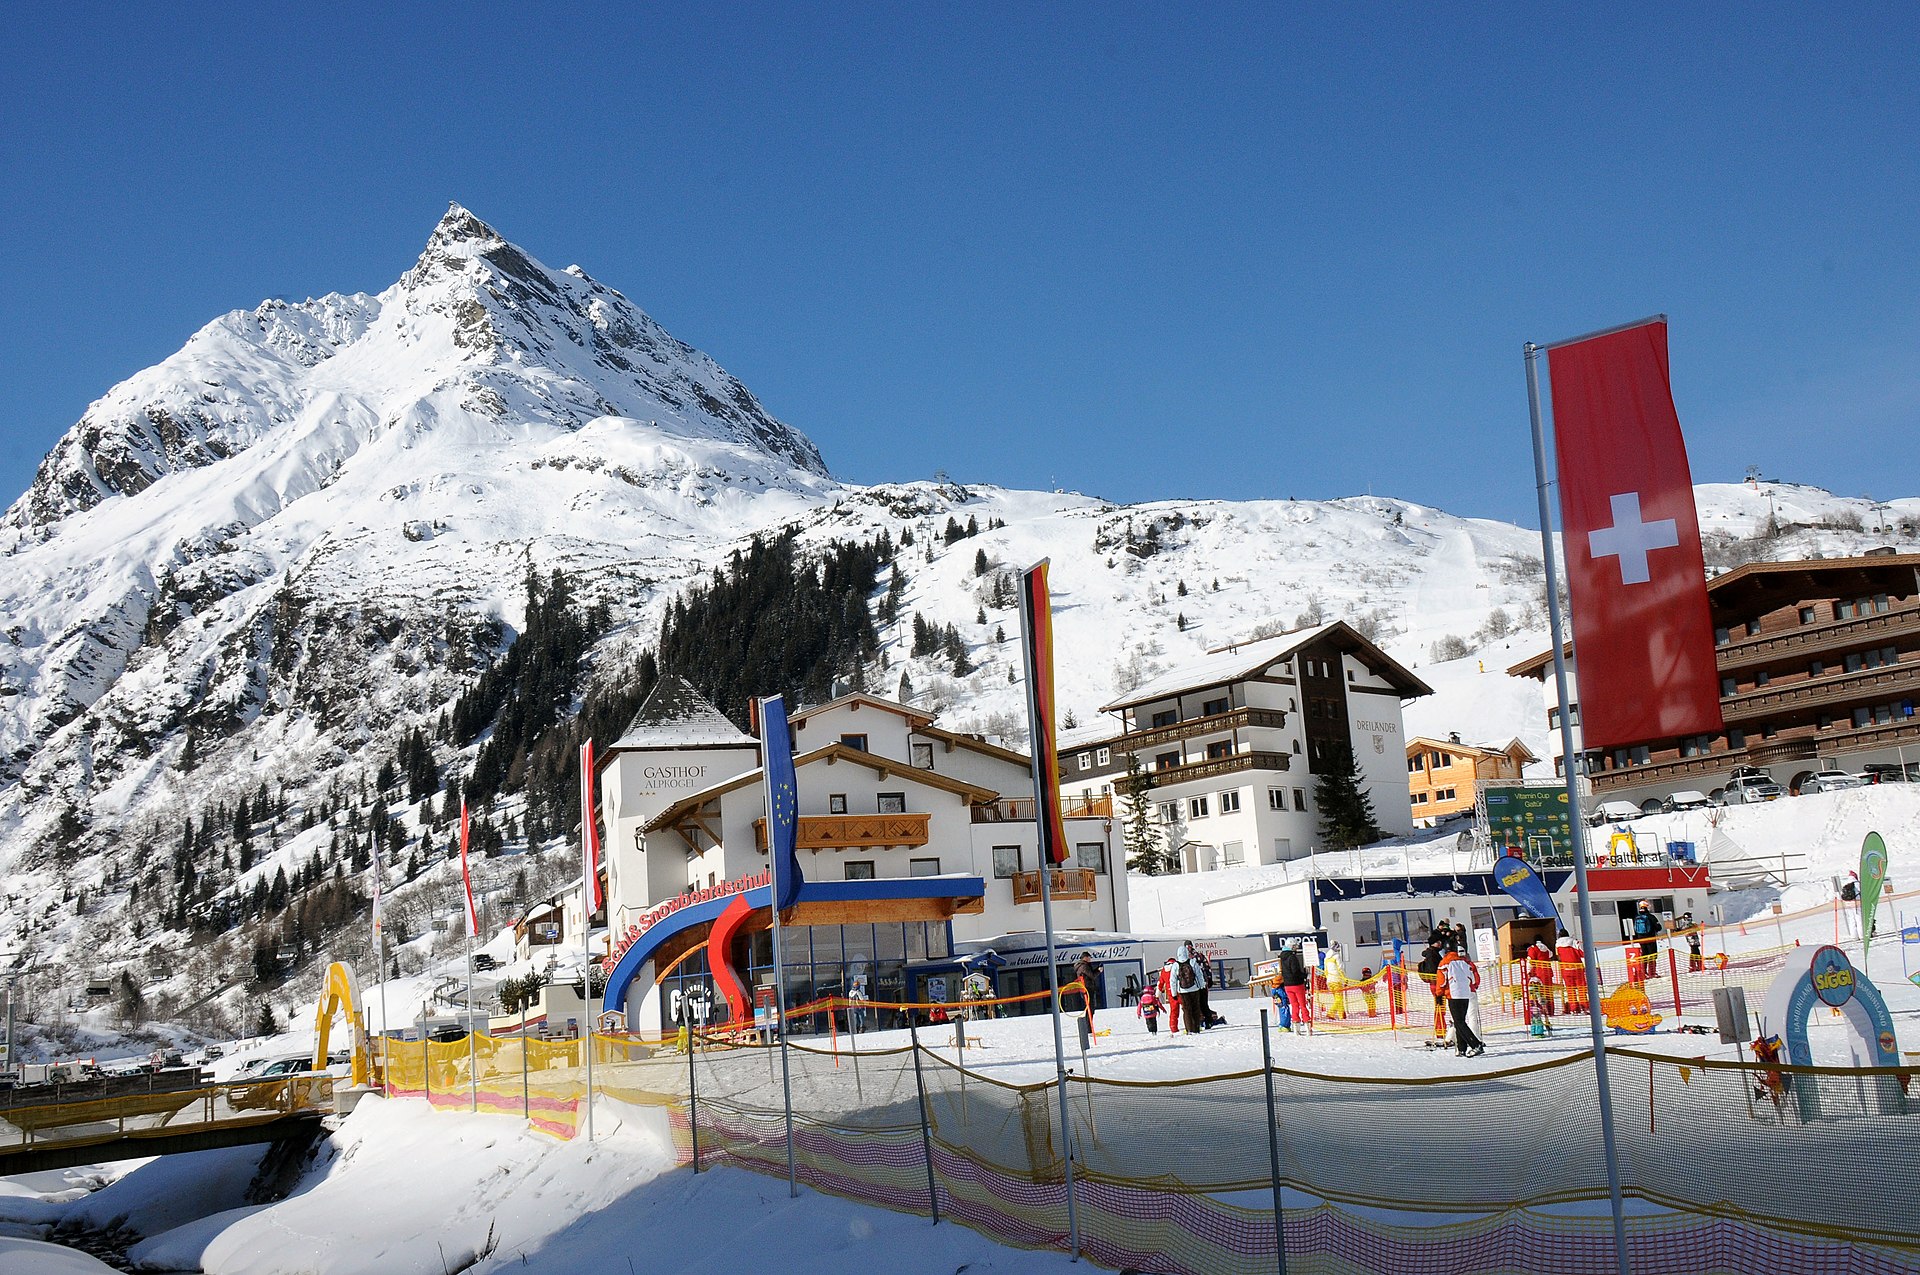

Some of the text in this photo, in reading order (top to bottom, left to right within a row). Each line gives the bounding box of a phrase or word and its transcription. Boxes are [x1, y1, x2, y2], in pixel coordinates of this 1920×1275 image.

[643, 766, 708, 779] GASTHOF
[645, 779, 695, 789] ALPKOGEL
[1514, 792, 1537, 800] Vitamin
[1536, 792, 1550, 800] Cup
[1545, 851, 1663, 867] schisule-galtuer.at
[1194, 942, 1217, 950] PRIVAT
[1279, 935, 1318, 949] DPOT
[1016, 951, 1068, 966] traditioell
[1108, 946, 1130, 959] 1927
[1815, 969, 1853, 991] SIGGI
